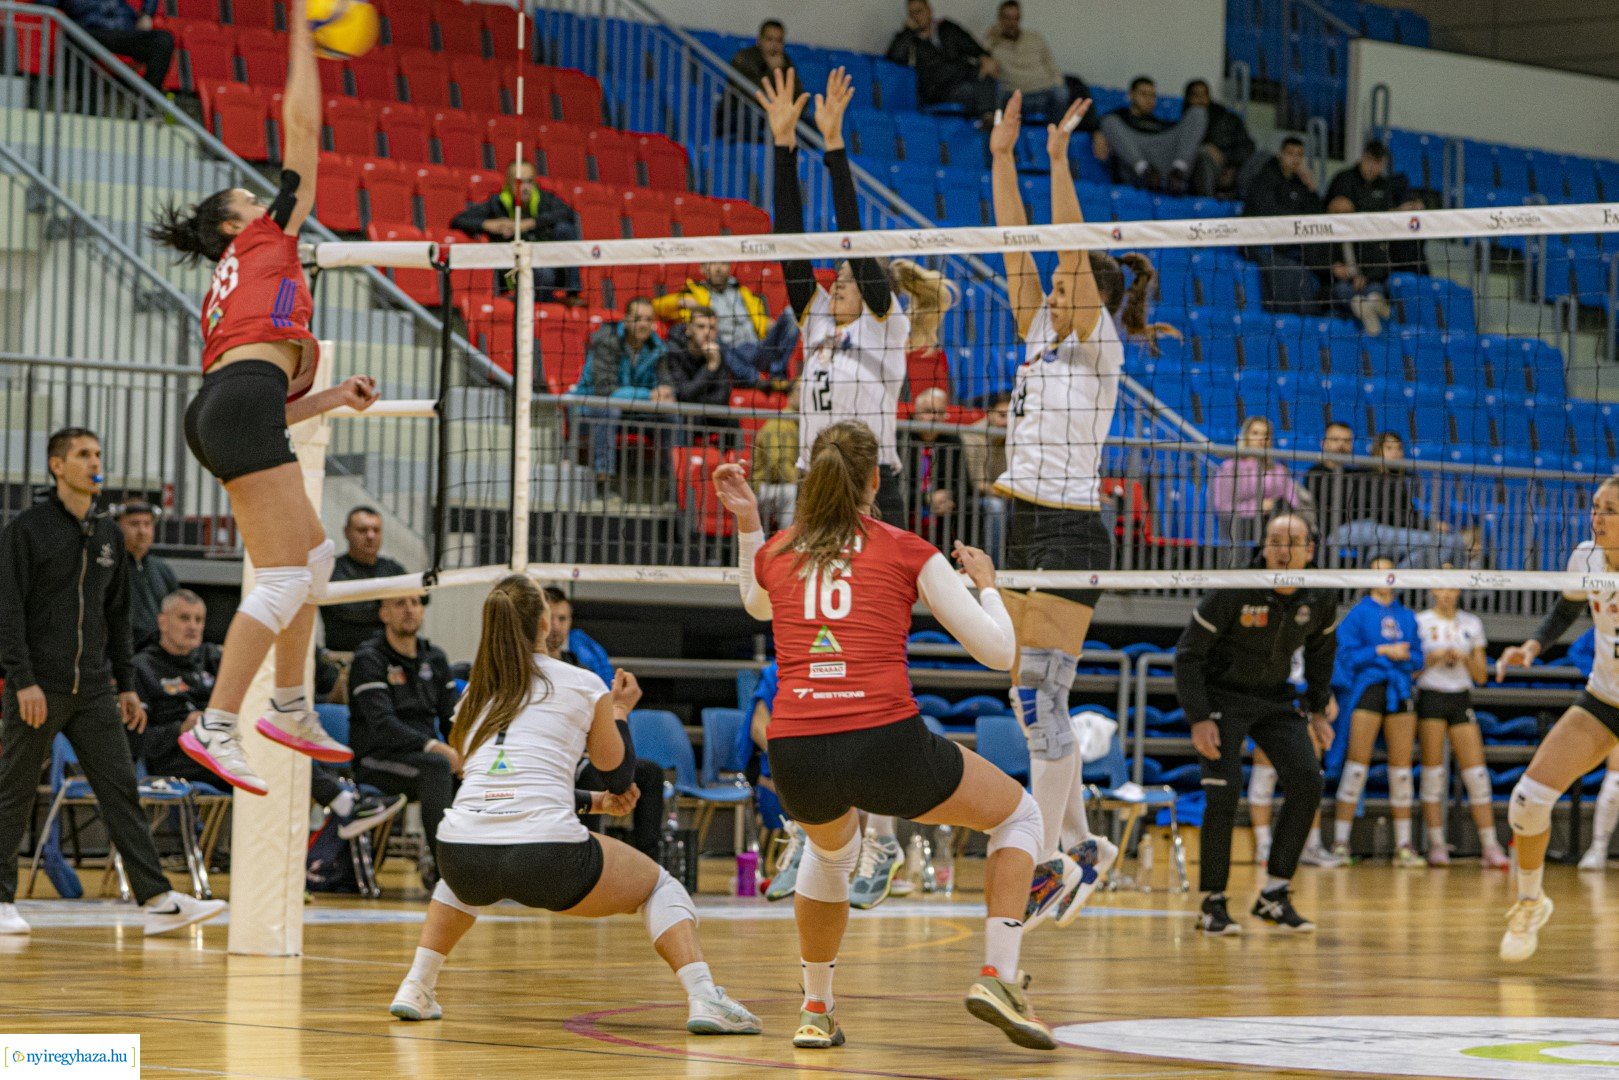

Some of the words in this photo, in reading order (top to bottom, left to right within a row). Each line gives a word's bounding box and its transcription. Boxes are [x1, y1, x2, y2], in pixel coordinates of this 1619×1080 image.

[1293, 220, 1335, 236] FATUM
[1003, 230, 1042, 245] FATUM
[812, 370, 832, 411] 12
[798, 559, 853, 620] 16
[1582, 576, 1617, 589] FATUM
